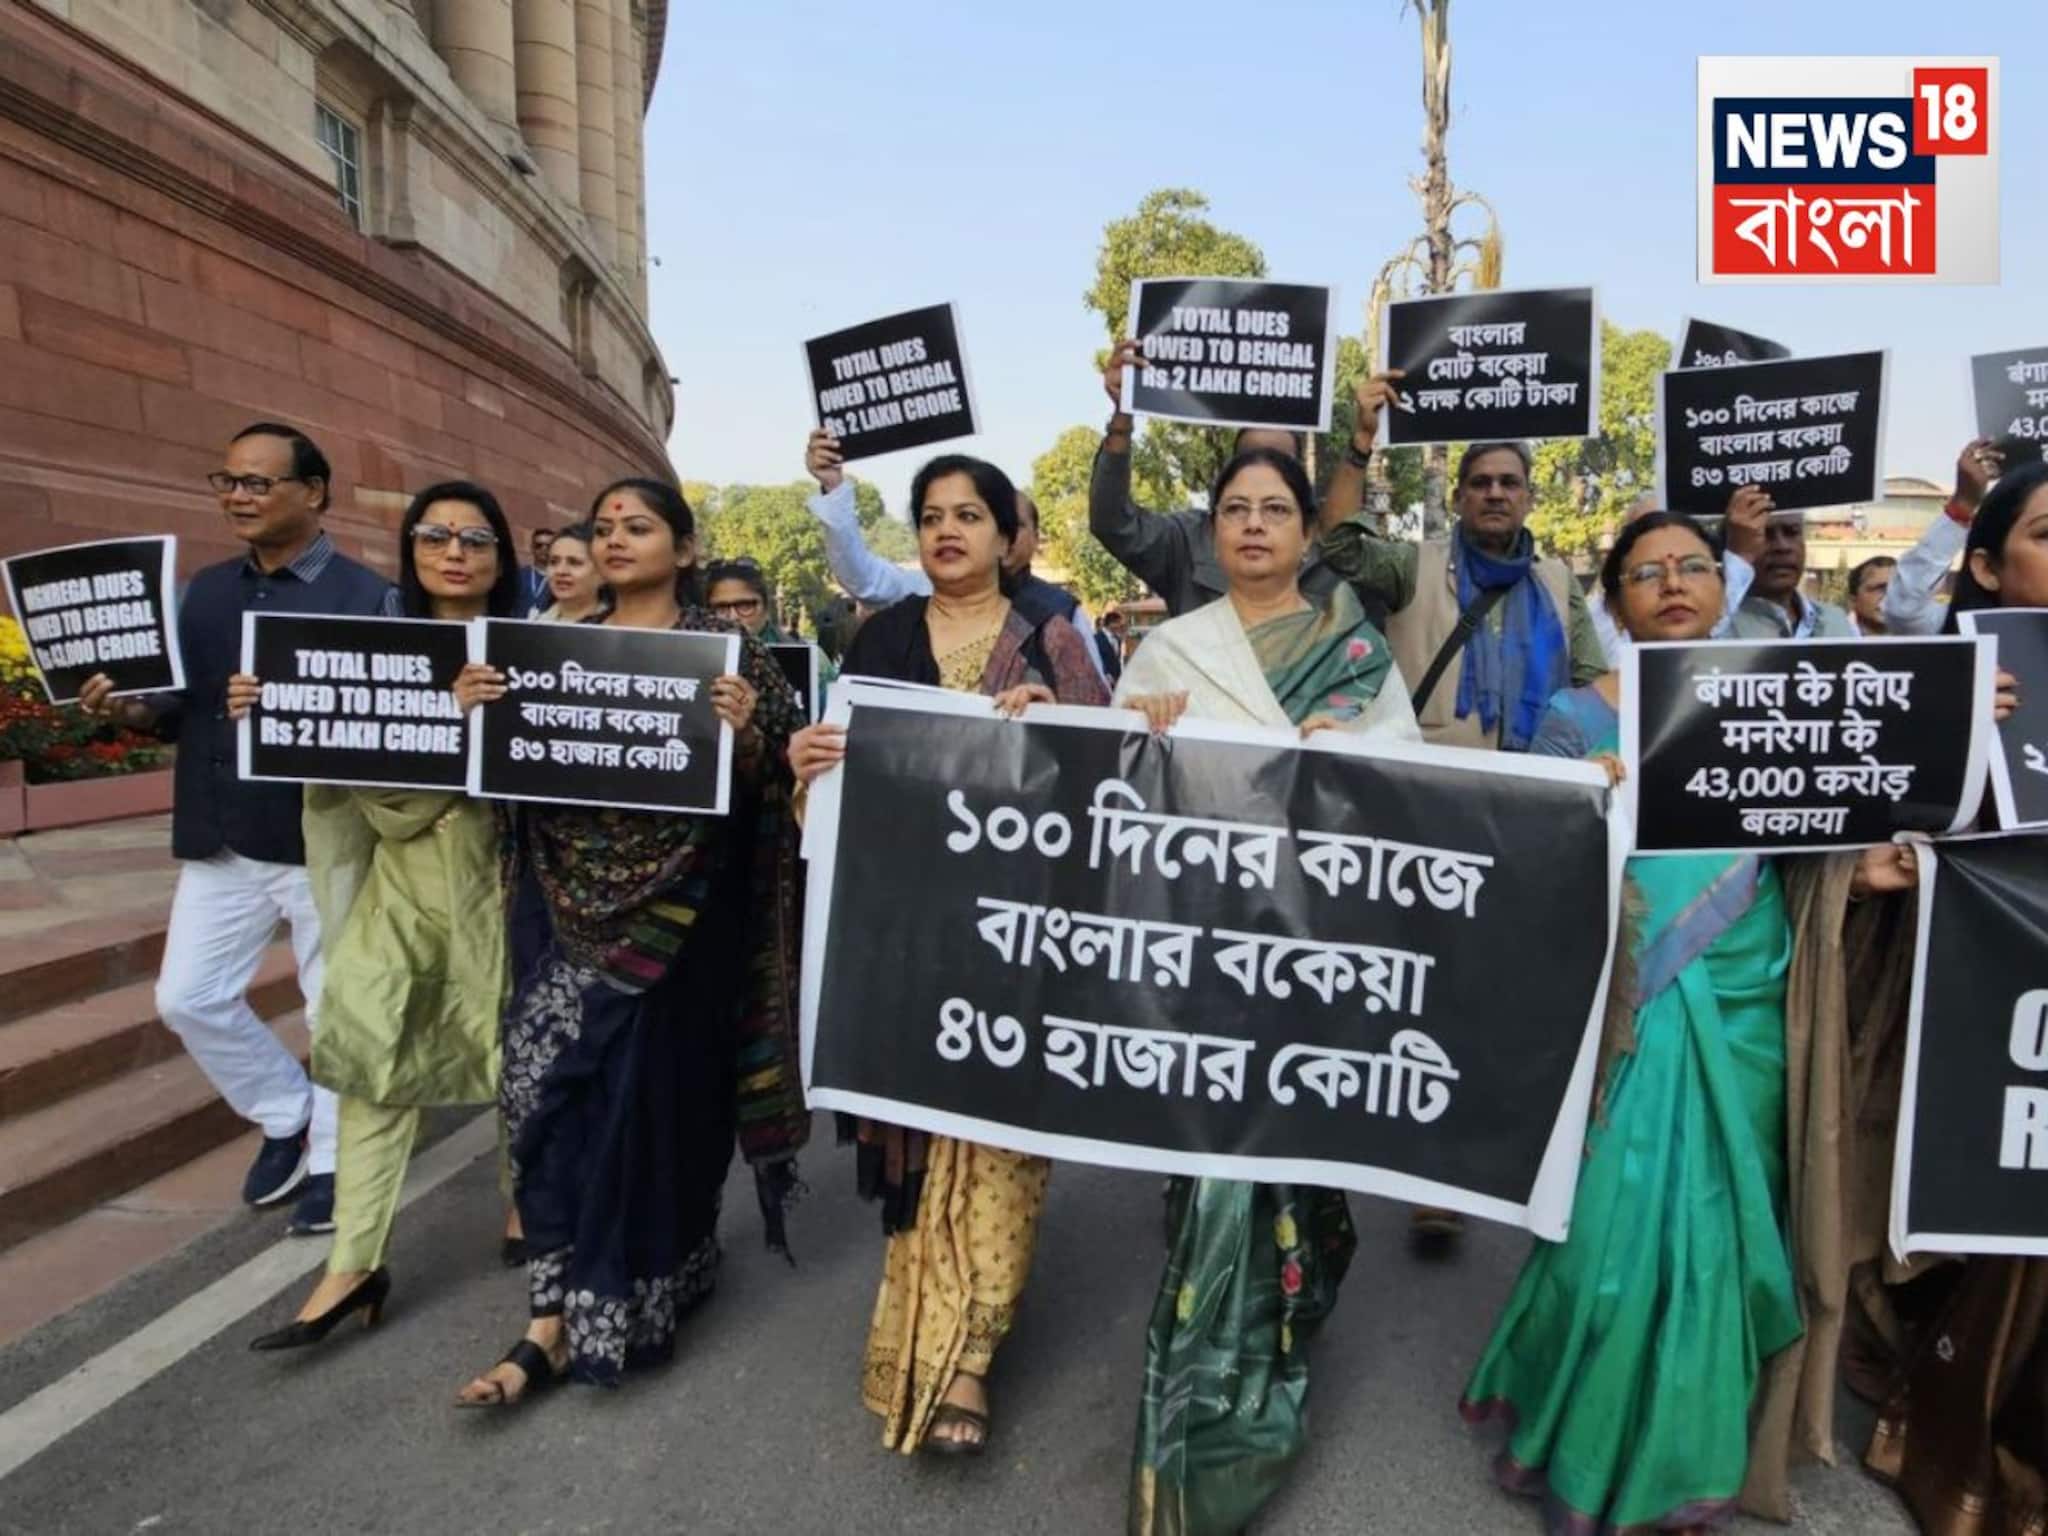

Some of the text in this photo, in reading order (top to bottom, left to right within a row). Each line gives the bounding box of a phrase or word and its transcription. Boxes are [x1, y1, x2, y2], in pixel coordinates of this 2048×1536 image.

[1171, 307, 1290, 338] TOTAL DUES
[1448, 321, 1527, 347] বাংলার
[832, 336, 927, 381] TOTAL DUES
[1142, 335, 1316, 369] OWED TO BENGAL
[1428, 351, 1548, 381] মোট বকেয়া
[819, 360, 957, 414] OWED TO BENGAL
[1141, 366, 1314, 399] Rs 2 LAKH CRORE
[1464, 376, 1525, 410] কোটি
[1526, 379, 1579, 406] টাকা
[845, 411, 860, 435] 2
[859, 401, 904, 432] LAKH
[902, 388, 963, 422] CRORE
[1685, 391, 1860, 428] ১০০ দিনের কাজে
[1699, 422, 1844, 456] বাংলার বকেয়া
[1691, 444, 1853, 487] ৪৩ হাজার কোটি
[92, 569, 145, 601] DUES
[60, 609, 83, 636] TO
[82, 599, 156, 633] BENGAL
[96, 629, 161, 661] CRORE
[295, 649, 432, 684] TOTAL DUES
[507, 659, 700, 703] ১০০ দিনের কাজে
[260, 683, 335, 713] OWED
[339, 686, 372, 716] TO
[1692, 659, 1915, 712] बंगाल के लिए
[260, 716, 462, 754] Rs 2 LAKH CRORE
[520, 701, 683, 737] বাংলার বকেয়া
[1720, 707, 1883, 755] मनरेगा के
[509, 737, 693, 773] ৪৩ হাজার কোটি
[1685, 755, 1916, 803] 43,000 करोड़
[1740, 806, 1850, 836] बकाया
[946, 779, 1495, 918] ১০০ দিনের কাজে
[975, 896, 1435, 1016] বাংলার বকেয়া
[936, 998, 1460, 1124] ৪৩ হাজার কোটি
